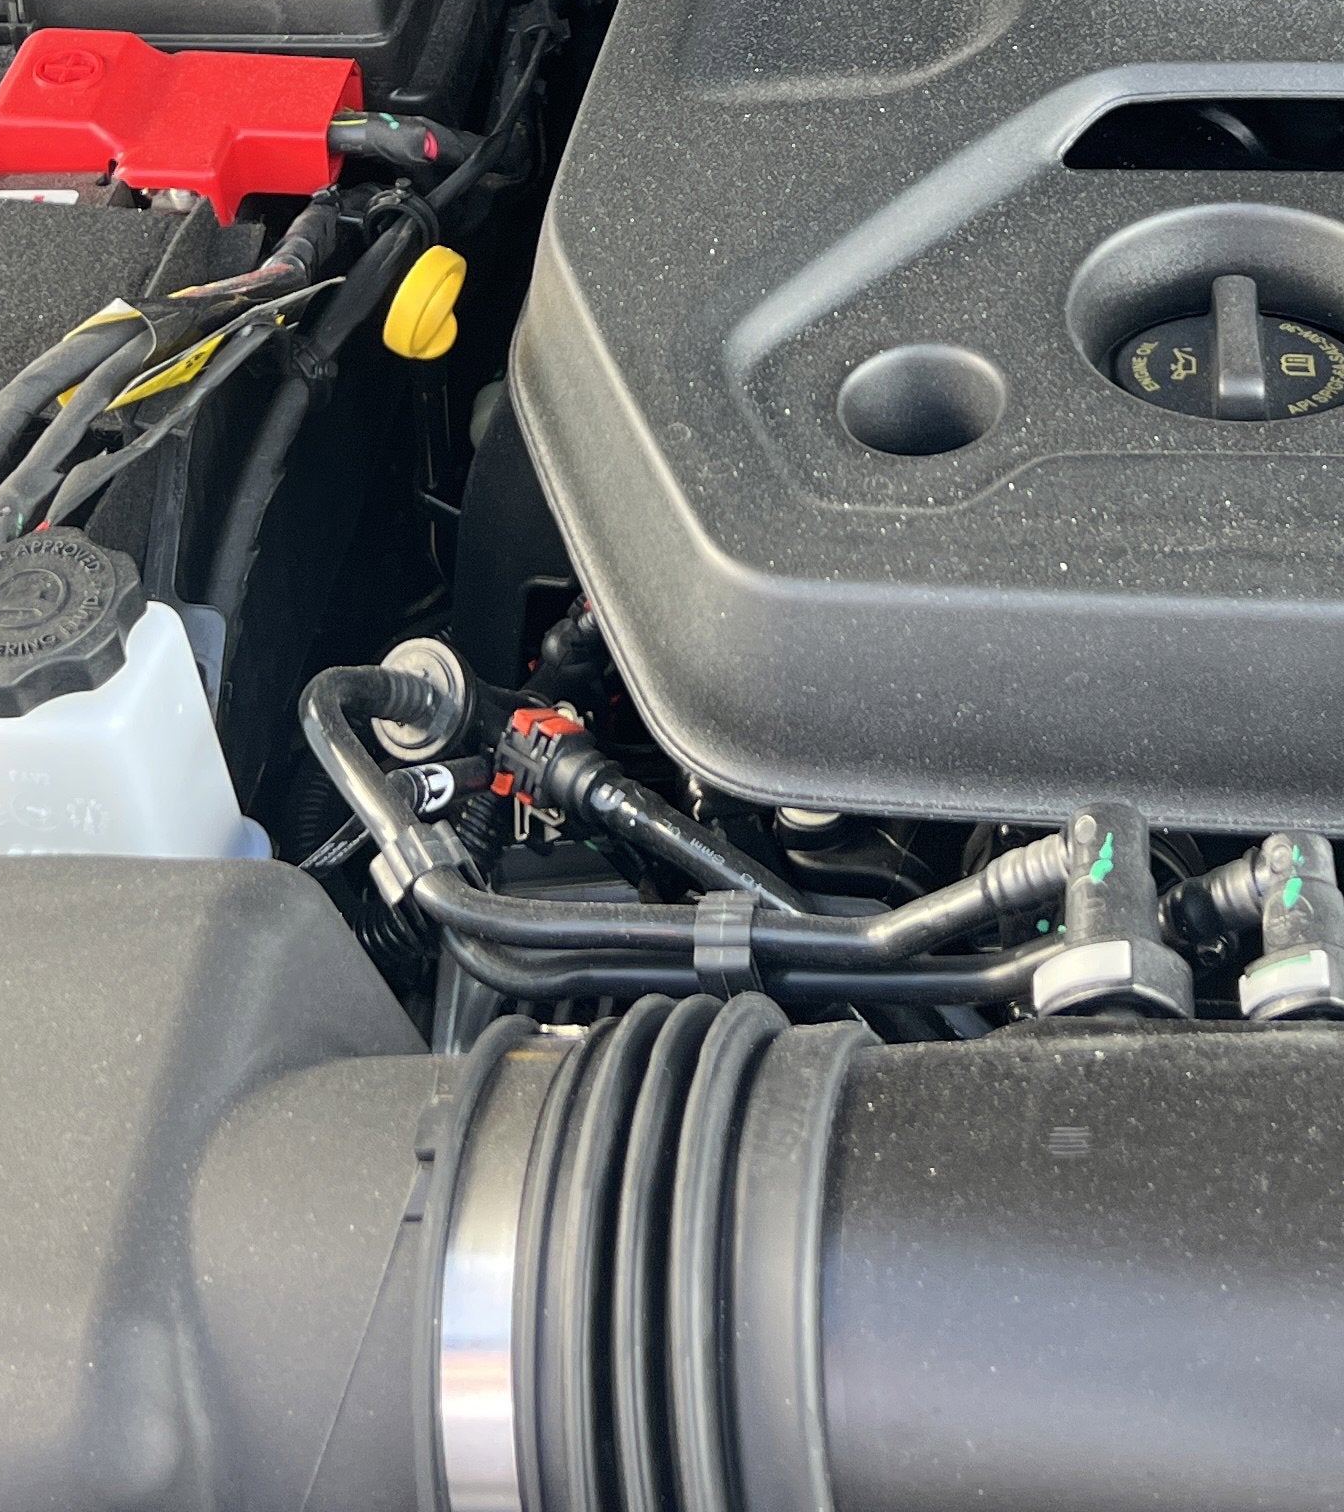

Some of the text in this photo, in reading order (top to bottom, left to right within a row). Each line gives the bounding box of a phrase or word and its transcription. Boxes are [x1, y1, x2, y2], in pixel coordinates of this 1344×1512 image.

[1131, 341, 1161, 392] ENGINE OIL
[1287, 398, 1319, 415] API
[15, 540, 101, 574] APPROVED
